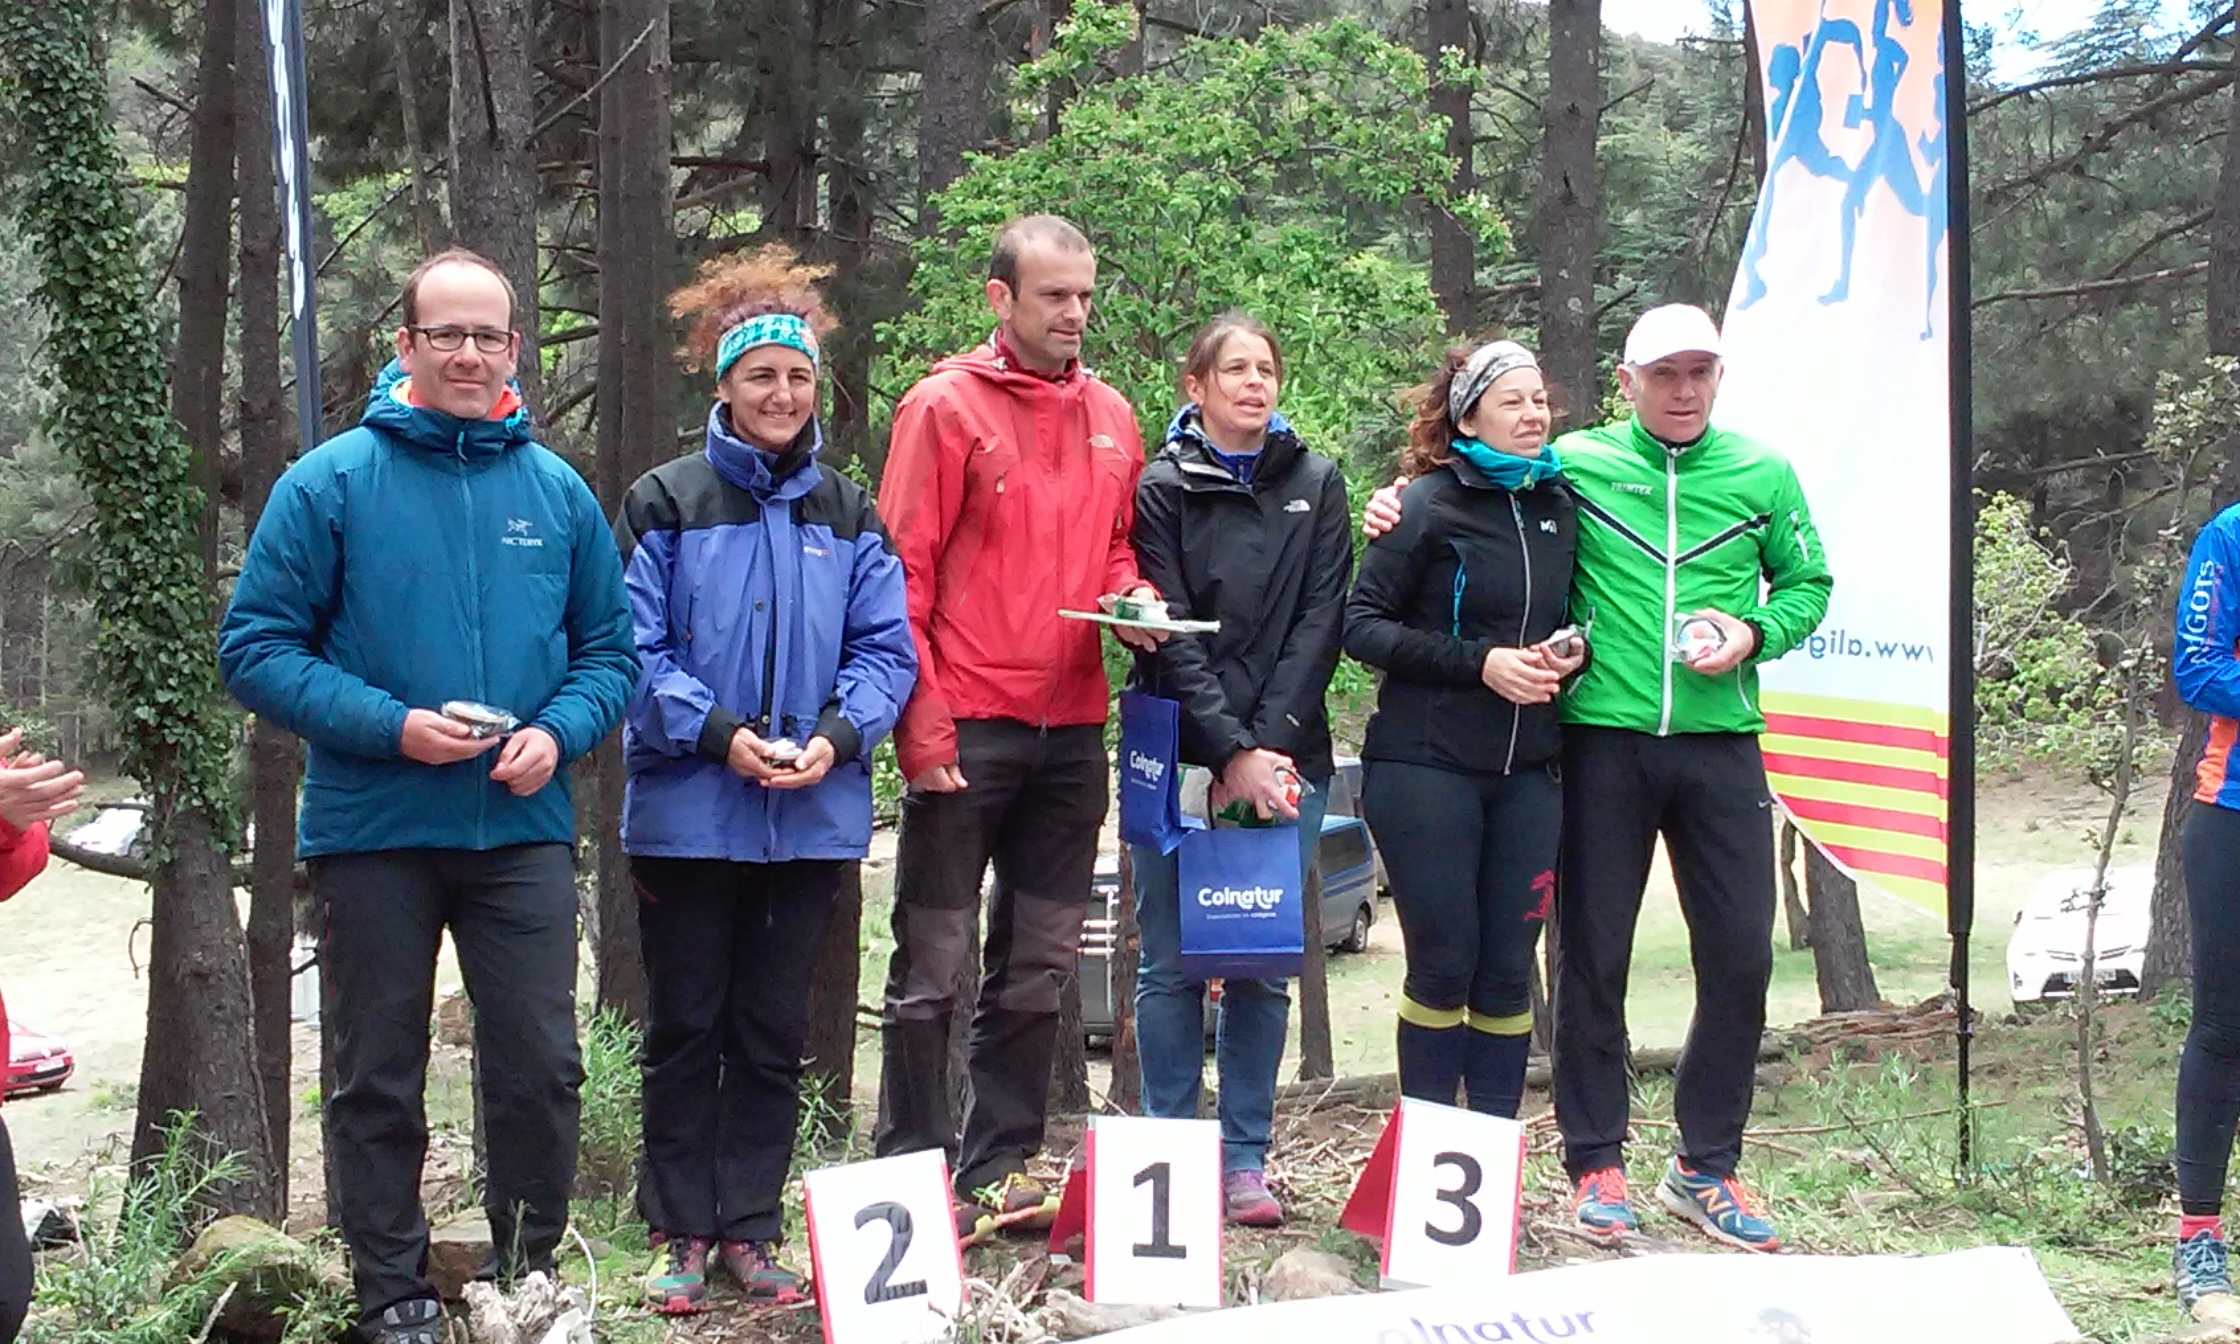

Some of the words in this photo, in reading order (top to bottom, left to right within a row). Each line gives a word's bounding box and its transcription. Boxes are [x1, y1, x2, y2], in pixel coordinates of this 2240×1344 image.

[1130, 750, 1164, 782] Colnatur
[1197, 885, 1284, 910] Colnatur
[1133, 1162, 1187, 1259] 1
[1425, 1152, 1482, 1246] 3
[856, 1207, 928, 1305] 2
